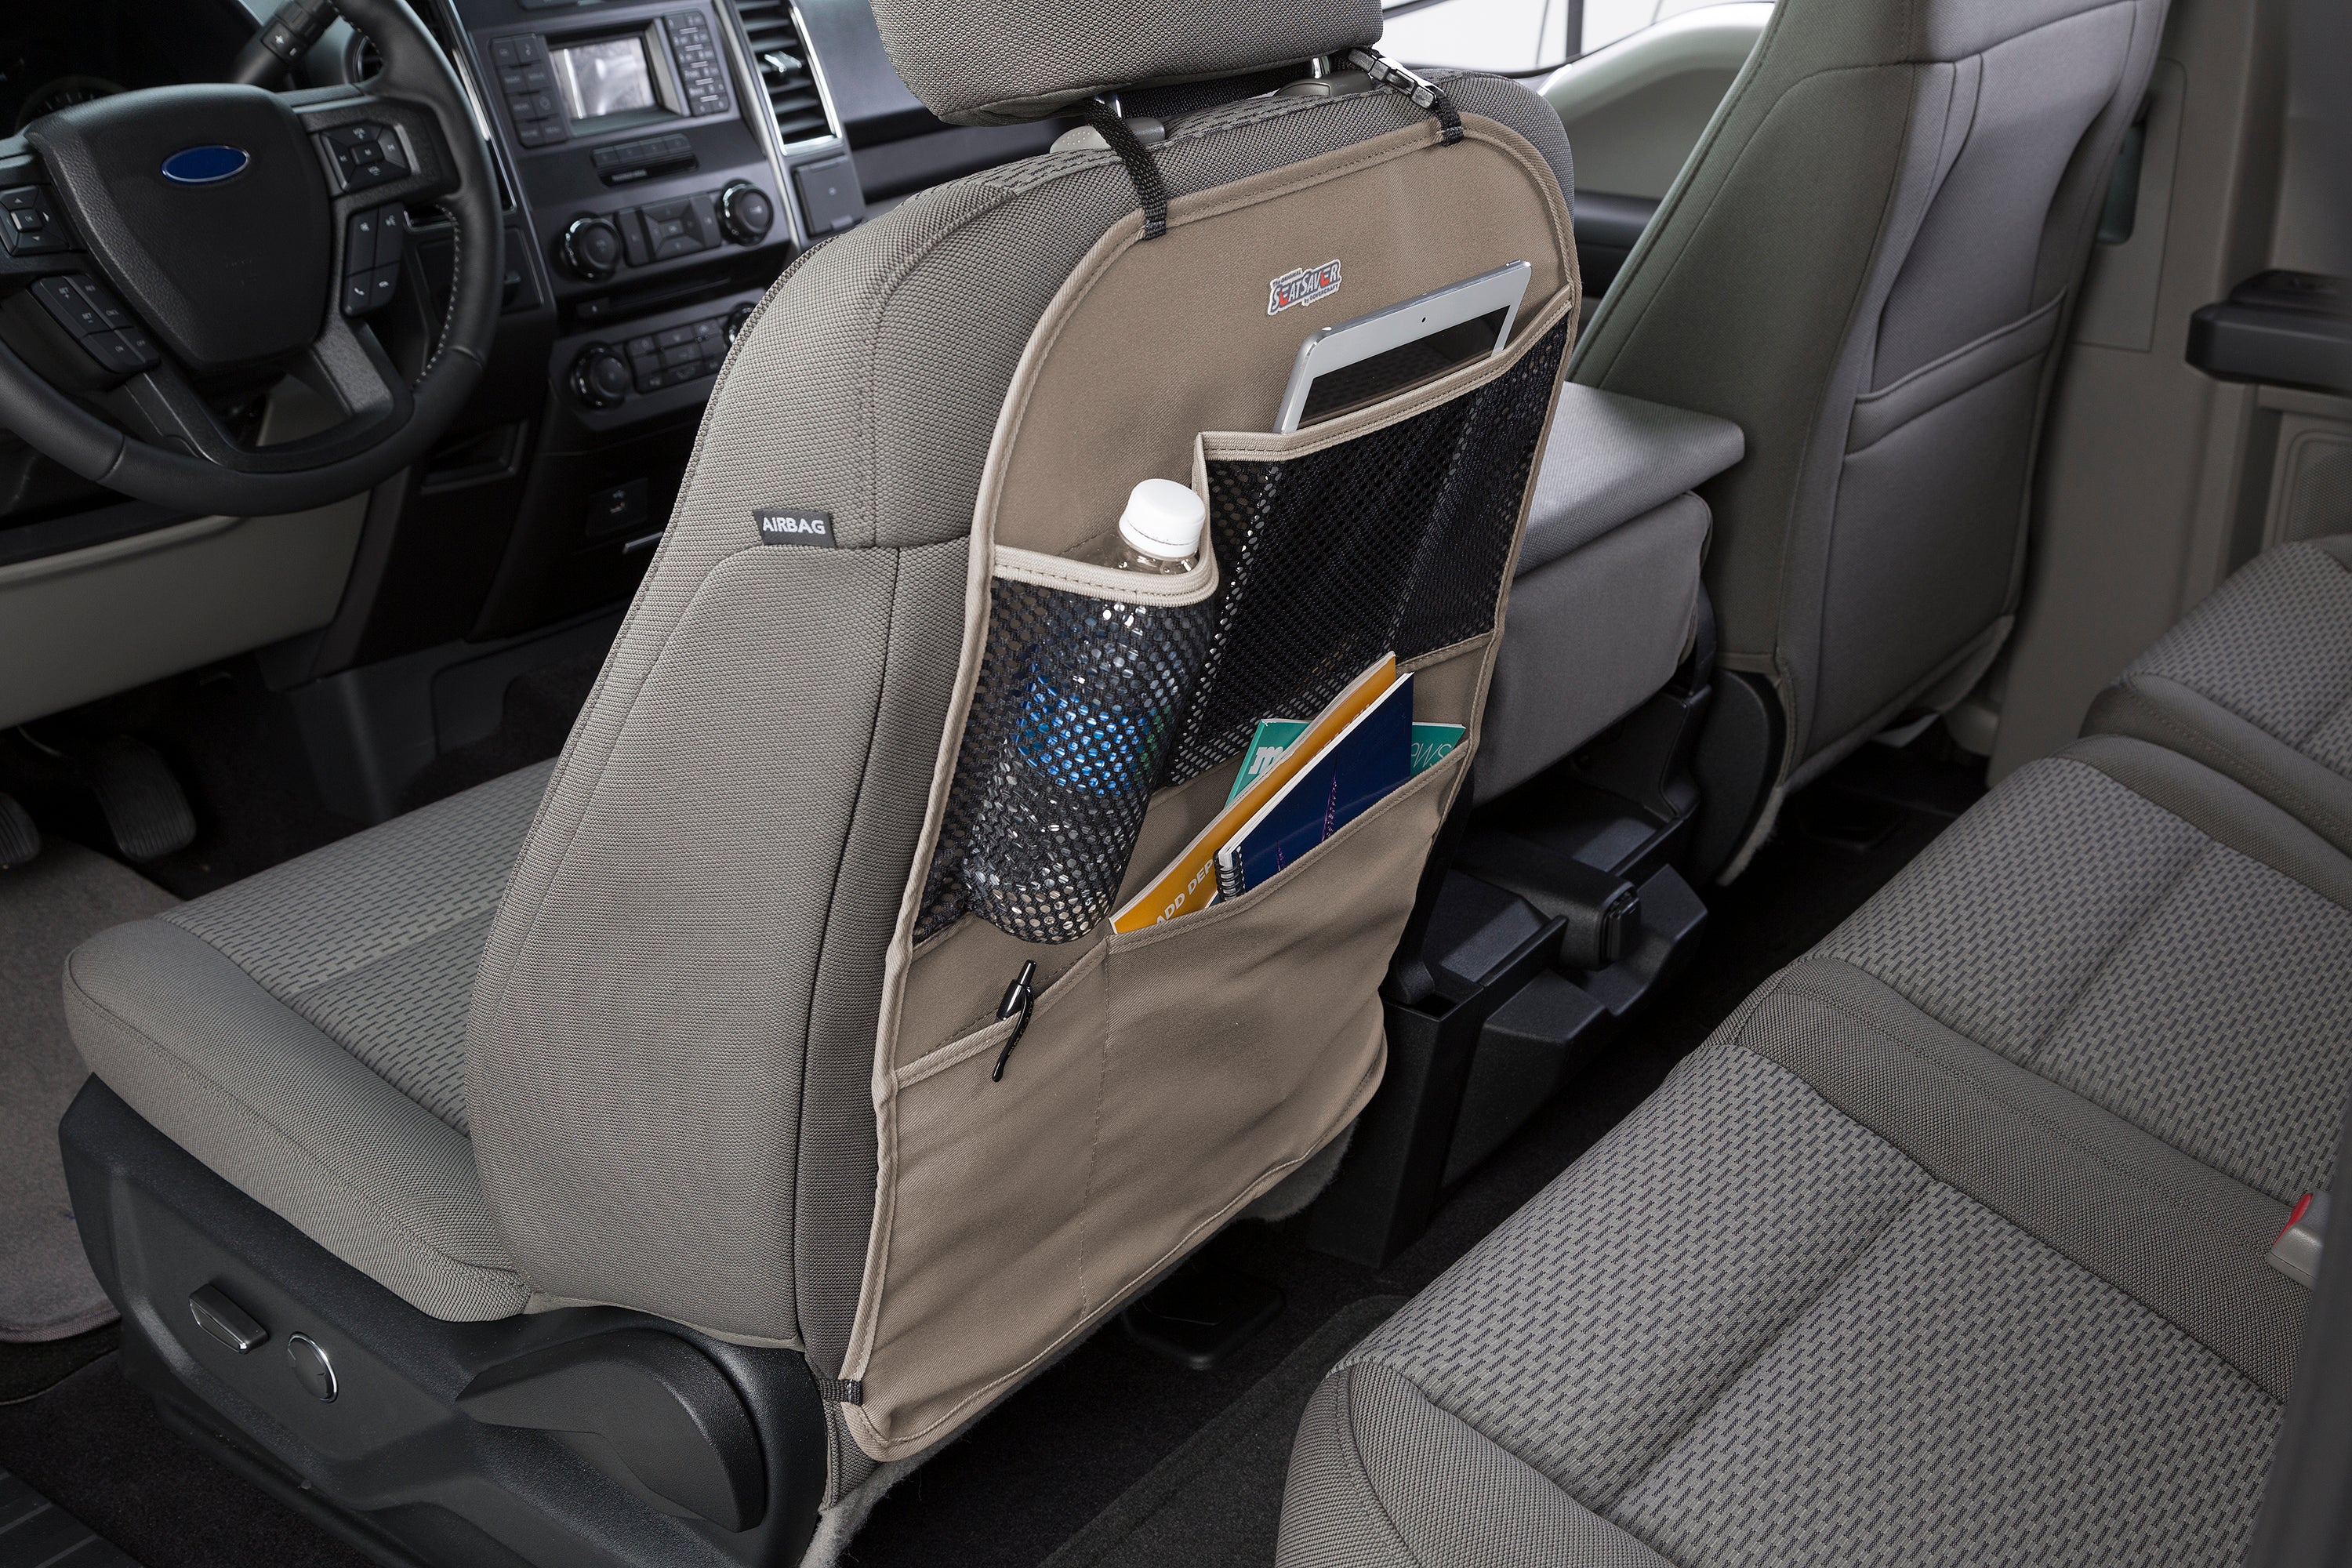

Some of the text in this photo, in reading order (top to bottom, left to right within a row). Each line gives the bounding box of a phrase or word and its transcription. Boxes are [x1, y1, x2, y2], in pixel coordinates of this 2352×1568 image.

[1271, 263, 1340, 312] SEATSAVER
[762, 517, 826, 535] AIRBAG
[1156, 892, 1185, 924] ADD
